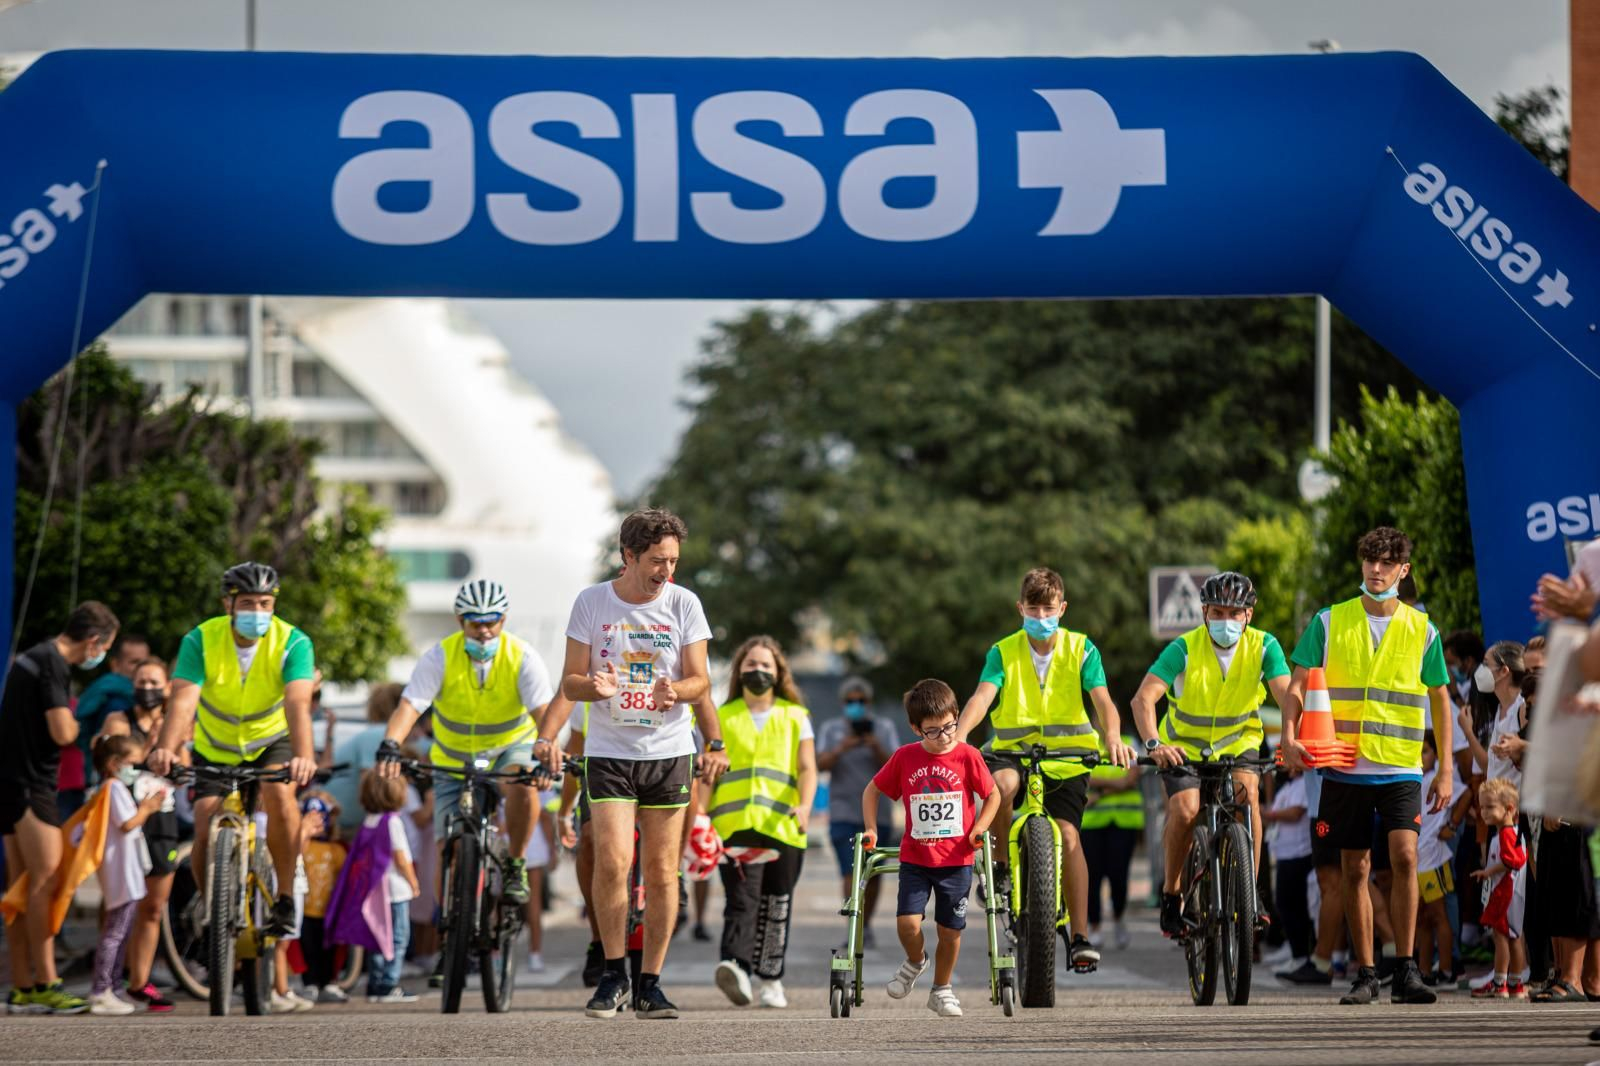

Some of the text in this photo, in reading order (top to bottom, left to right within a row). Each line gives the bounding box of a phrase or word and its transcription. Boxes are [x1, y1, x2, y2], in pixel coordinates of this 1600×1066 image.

[332, 89, 979, 246] asisa
[0, 208, 57, 290] sa
[1403, 162, 1541, 285] asisa
[620, 692, 657, 711] 383
[908, 765, 961, 786] AHOY MATEY
[918, 802, 955, 822] 632
